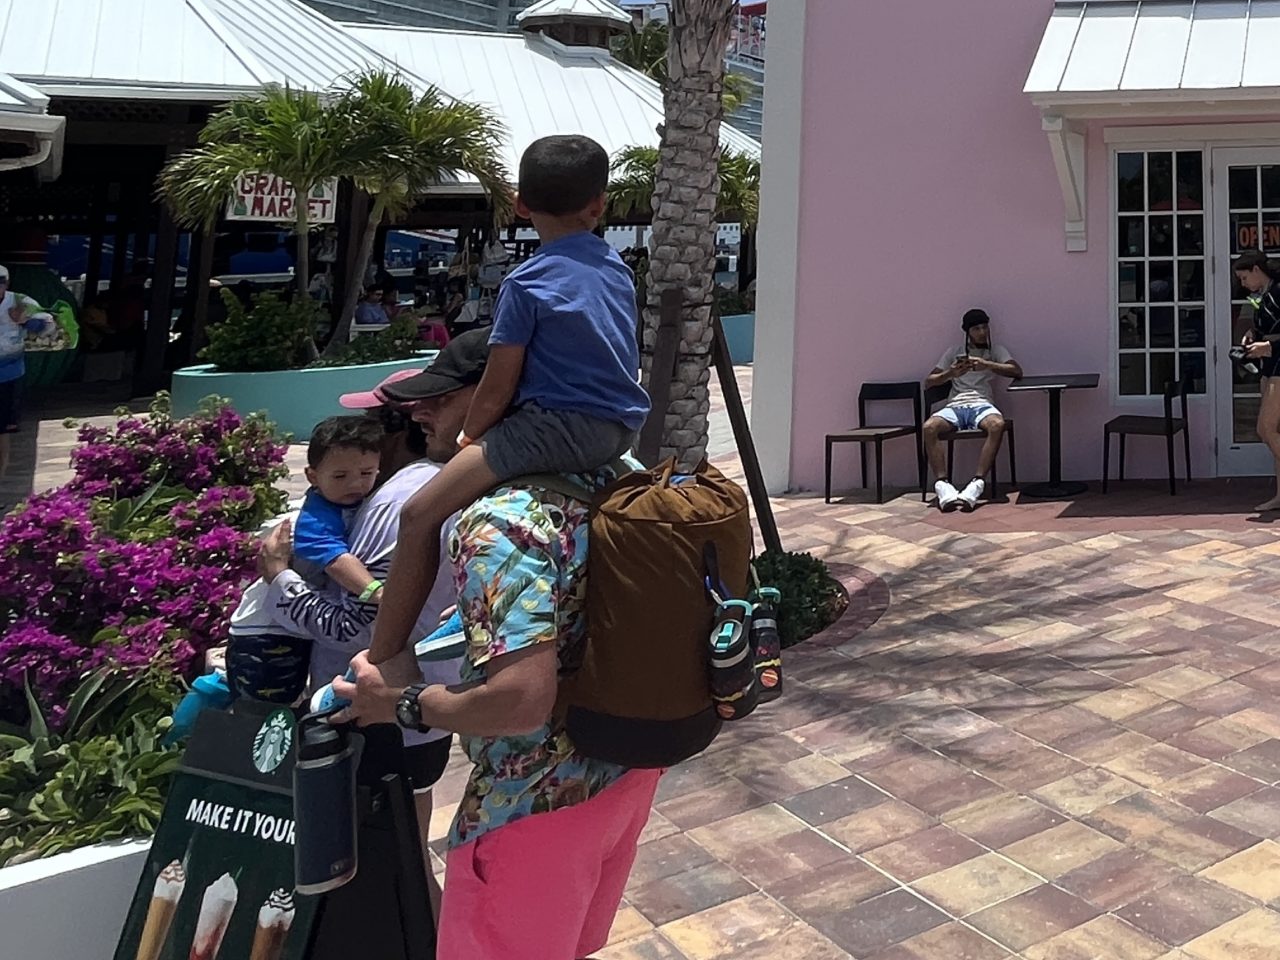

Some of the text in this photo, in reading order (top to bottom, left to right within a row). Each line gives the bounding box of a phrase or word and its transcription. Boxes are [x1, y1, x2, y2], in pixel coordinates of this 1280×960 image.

[240, 174, 296, 196] CRAF
[250, 196, 331, 219] MARET
[1239, 225, 1280, 248] OPEN
[184, 798, 235, 830] MAKE
[233, 809, 254, 833] IT
